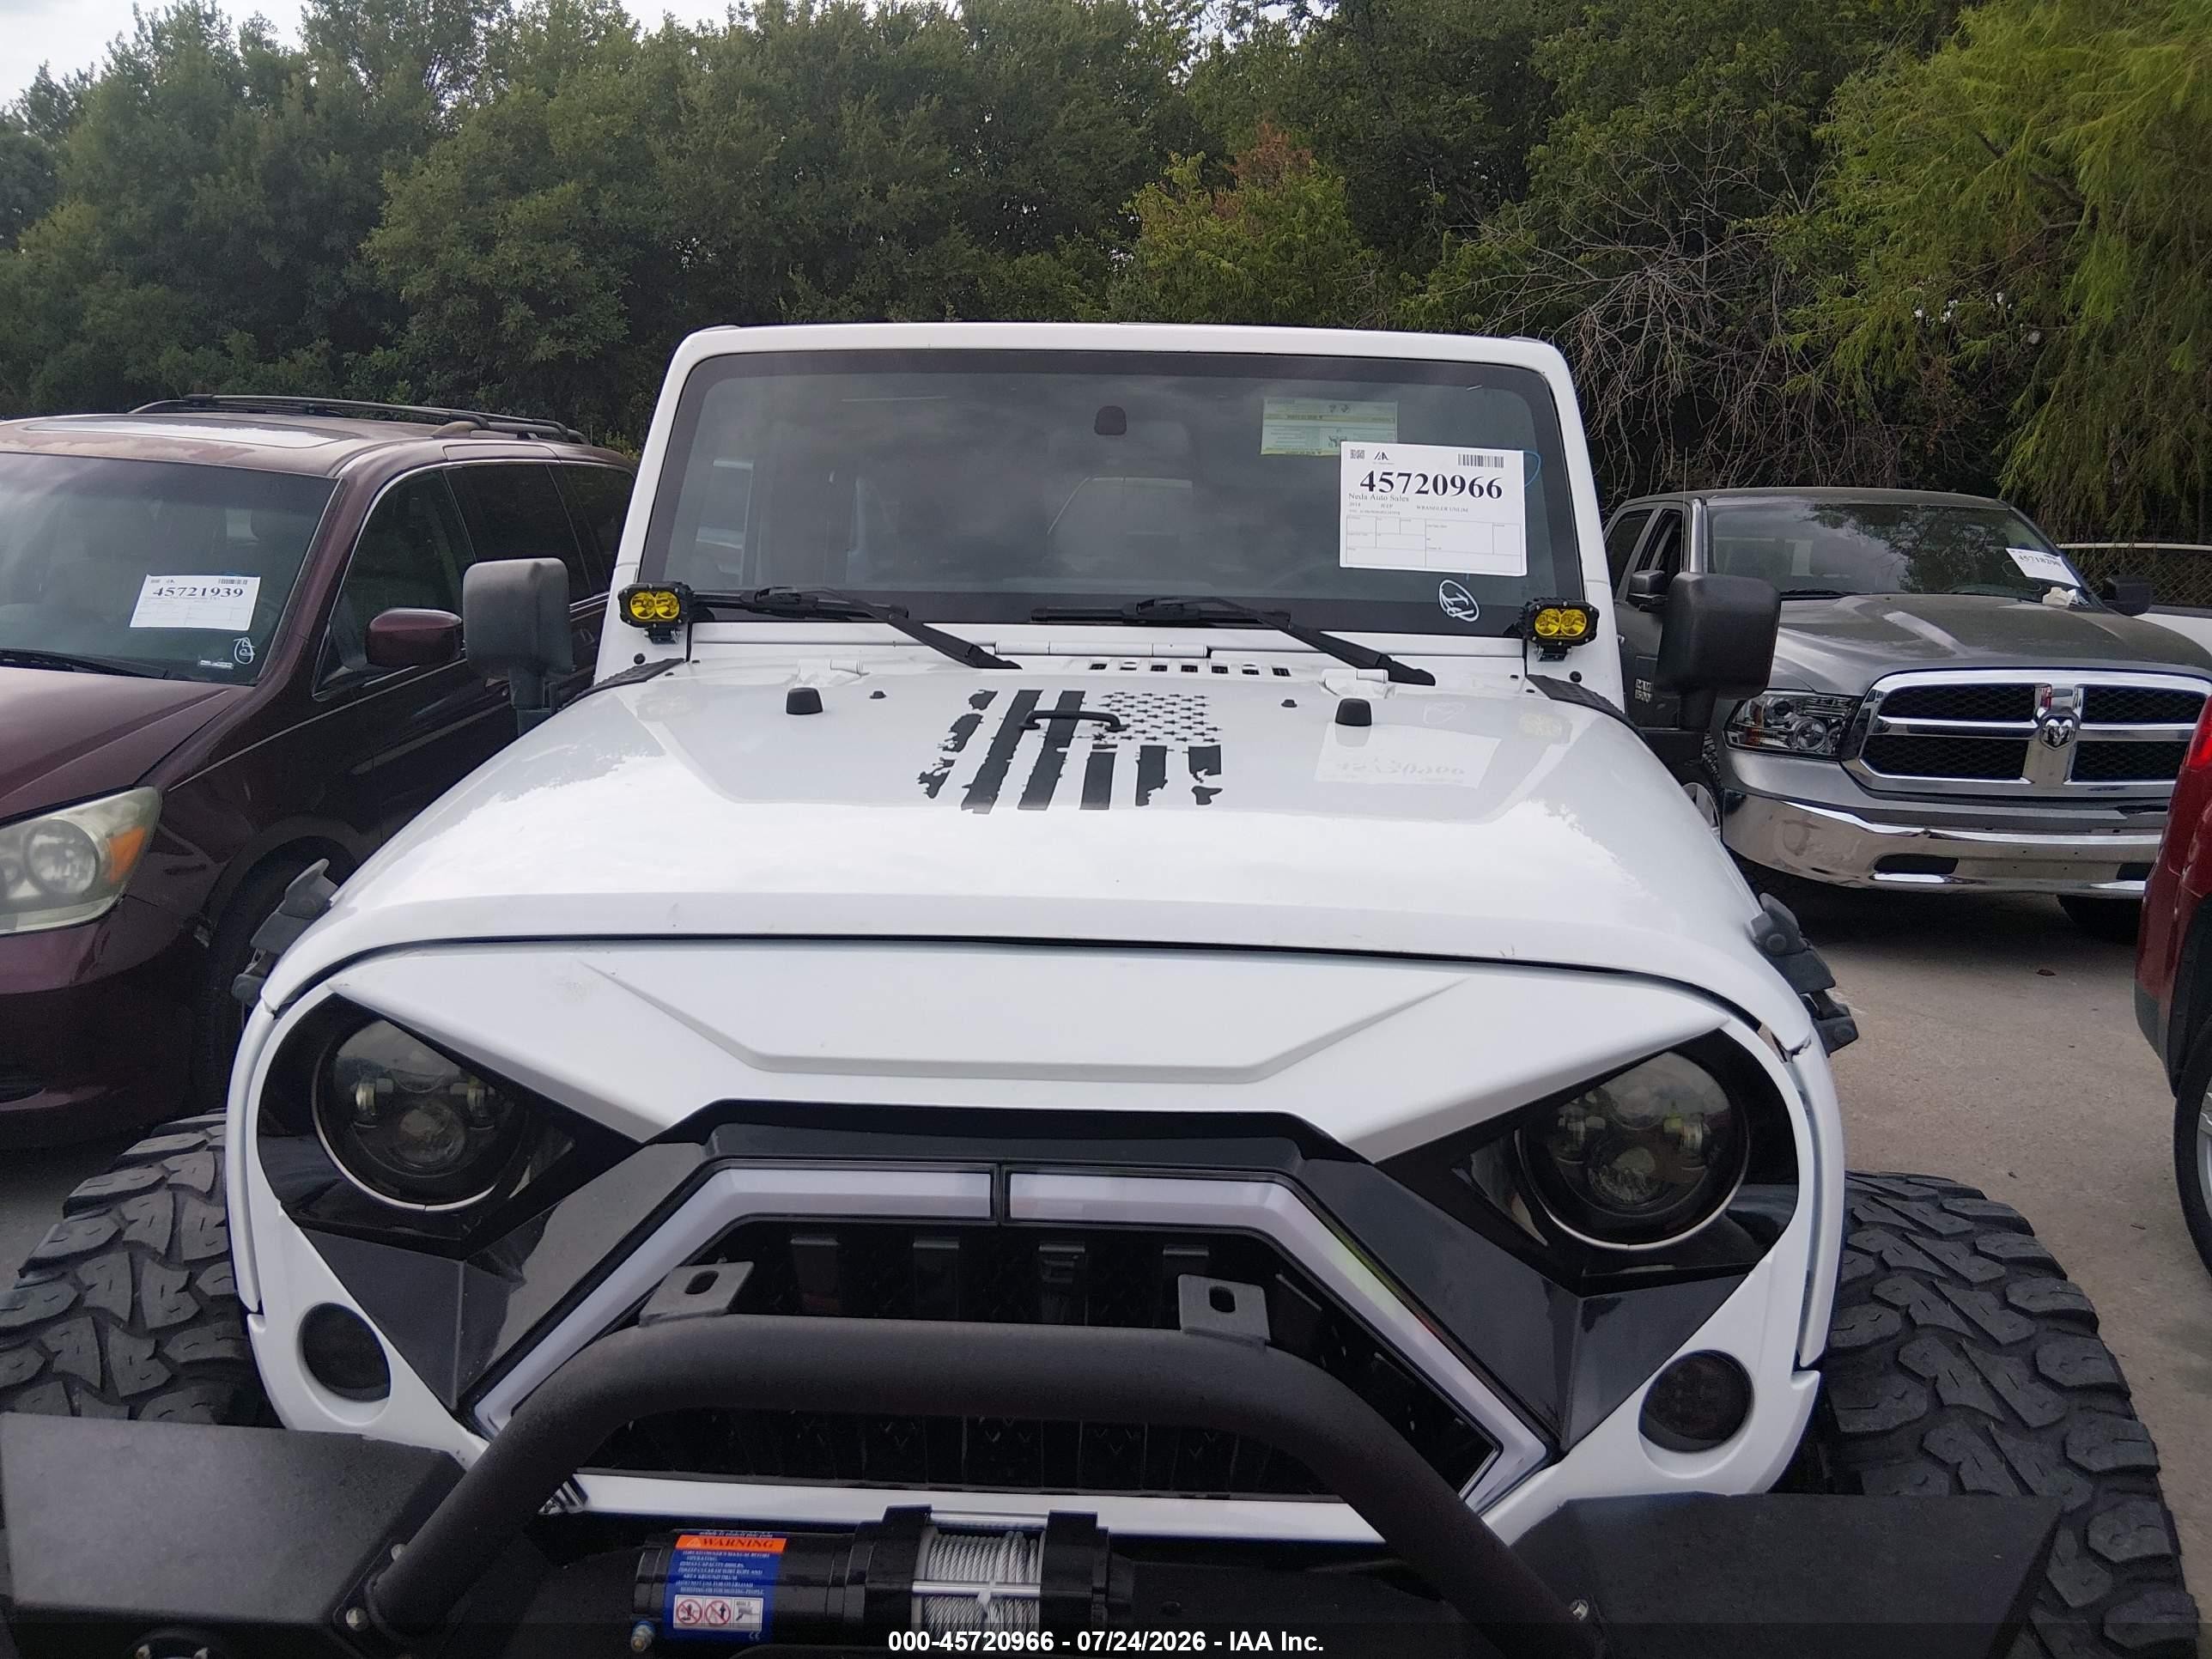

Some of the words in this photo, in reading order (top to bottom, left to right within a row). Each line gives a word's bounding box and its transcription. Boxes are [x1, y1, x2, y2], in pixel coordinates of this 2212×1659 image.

[1359, 471, 1503, 499] 45720966
[153, 586, 244, 598] 45721939
[703, 1538, 774, 1547] WARNING
